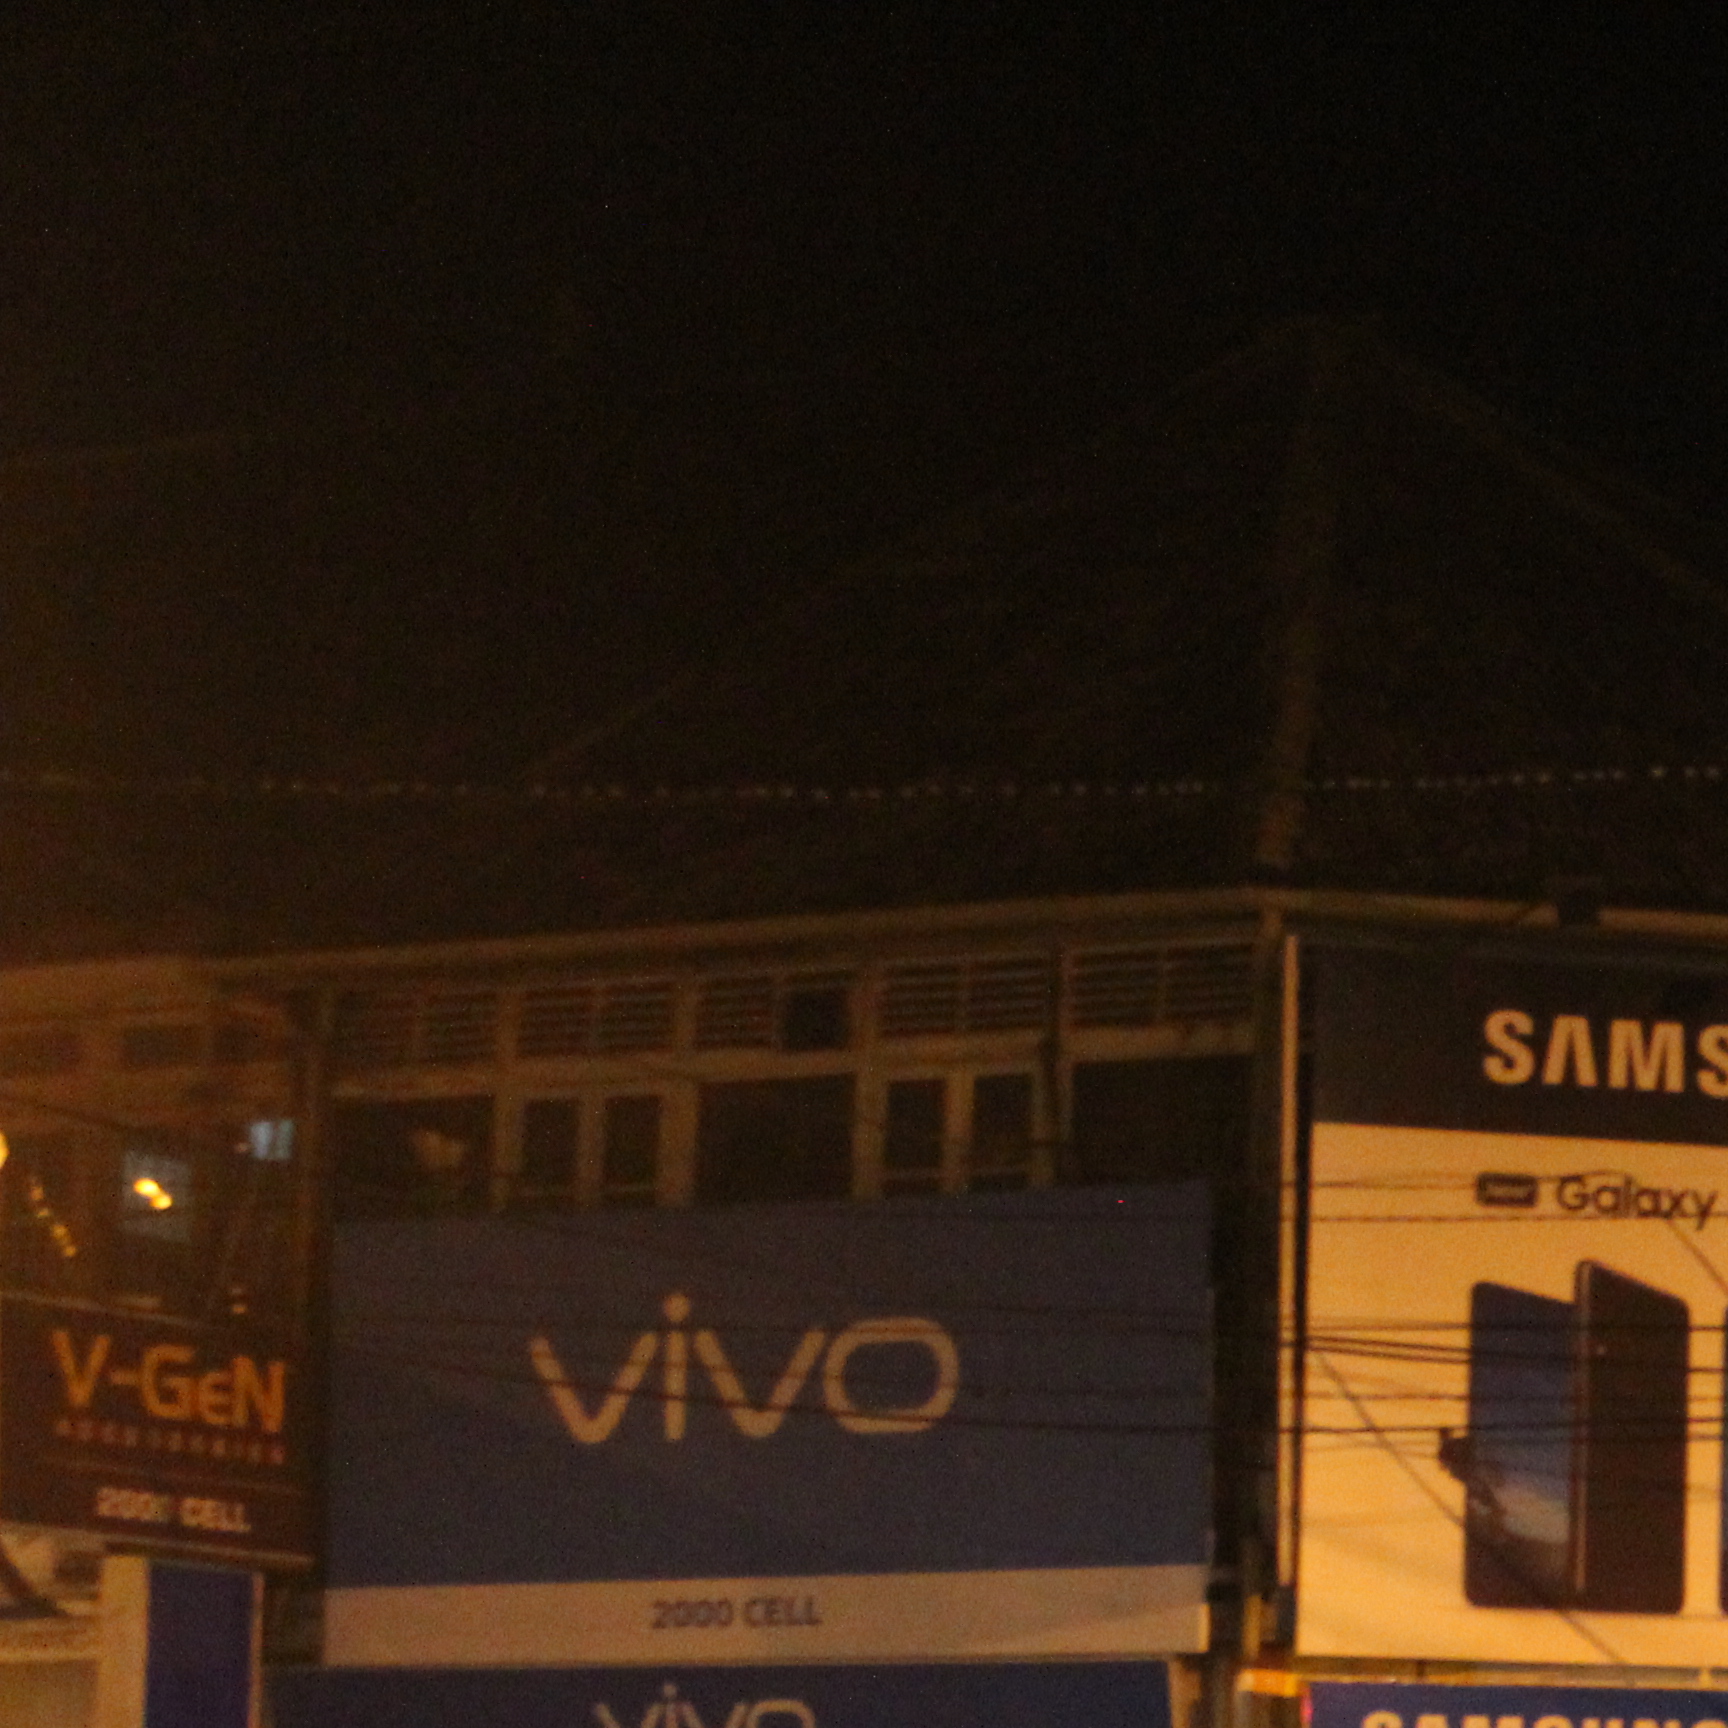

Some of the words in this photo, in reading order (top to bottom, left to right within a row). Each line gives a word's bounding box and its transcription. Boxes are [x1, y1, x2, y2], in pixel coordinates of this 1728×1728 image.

[1556, 1173, 1719, 1232] Galaxy
[528, 1292, 961, 1444] vivo
[652, 1599, 734, 1630] 2000
[741, 1595, 823, 1628] CELL
